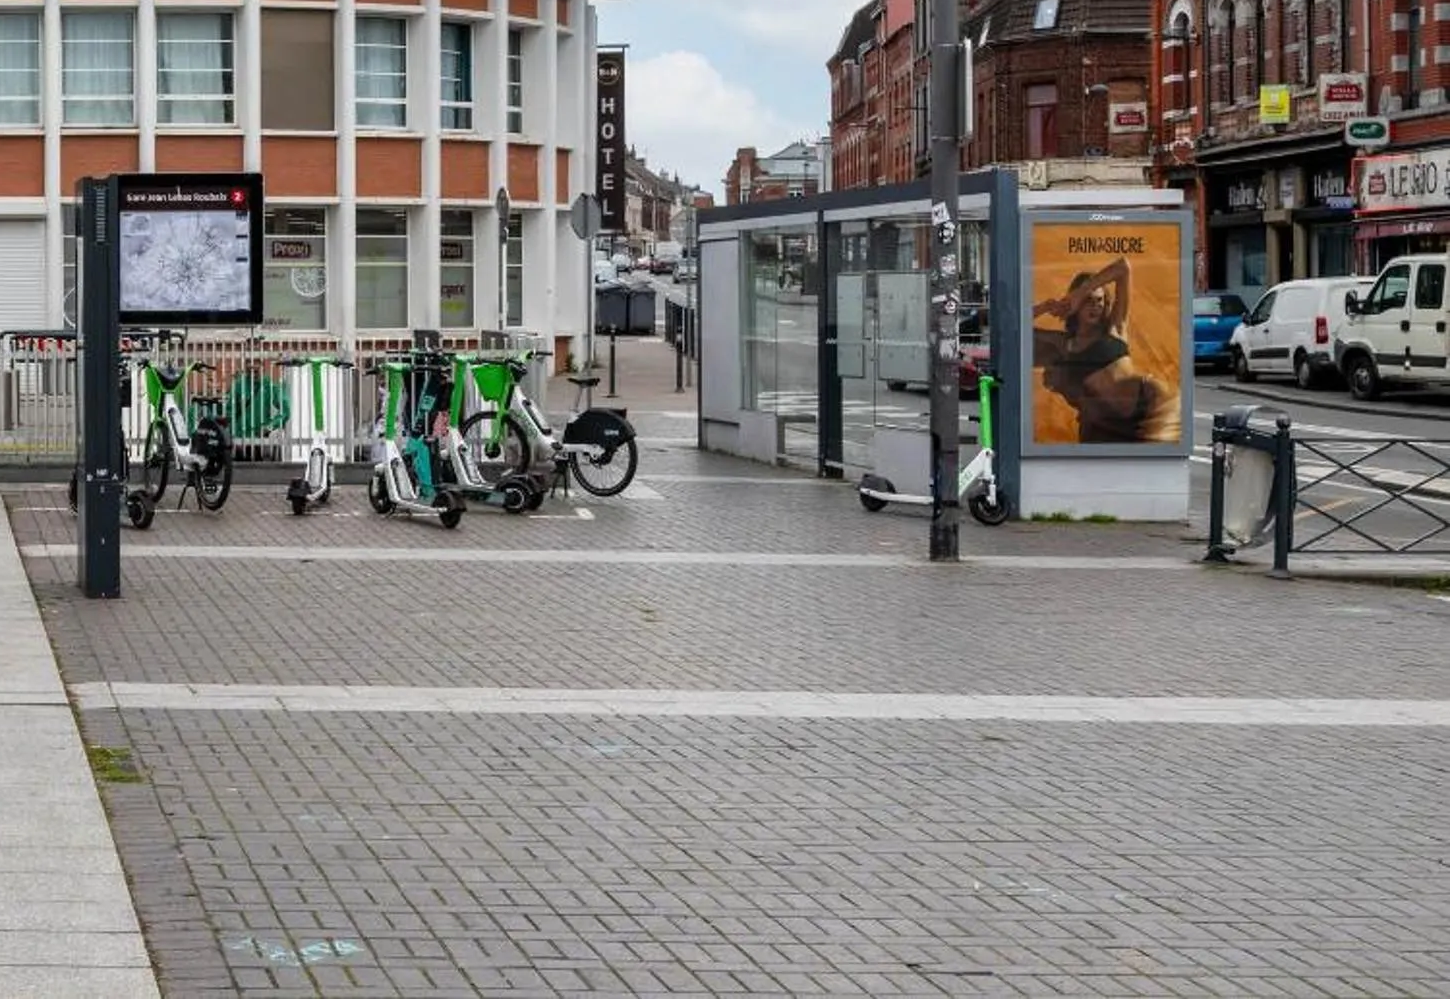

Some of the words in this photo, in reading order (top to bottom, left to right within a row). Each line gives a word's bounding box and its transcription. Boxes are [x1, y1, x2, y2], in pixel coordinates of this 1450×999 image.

[600, 97, 616, 216] HOTEL
[1068, 236, 1097, 254] PAIN
[1105, 236, 1145, 254] SUCRE
